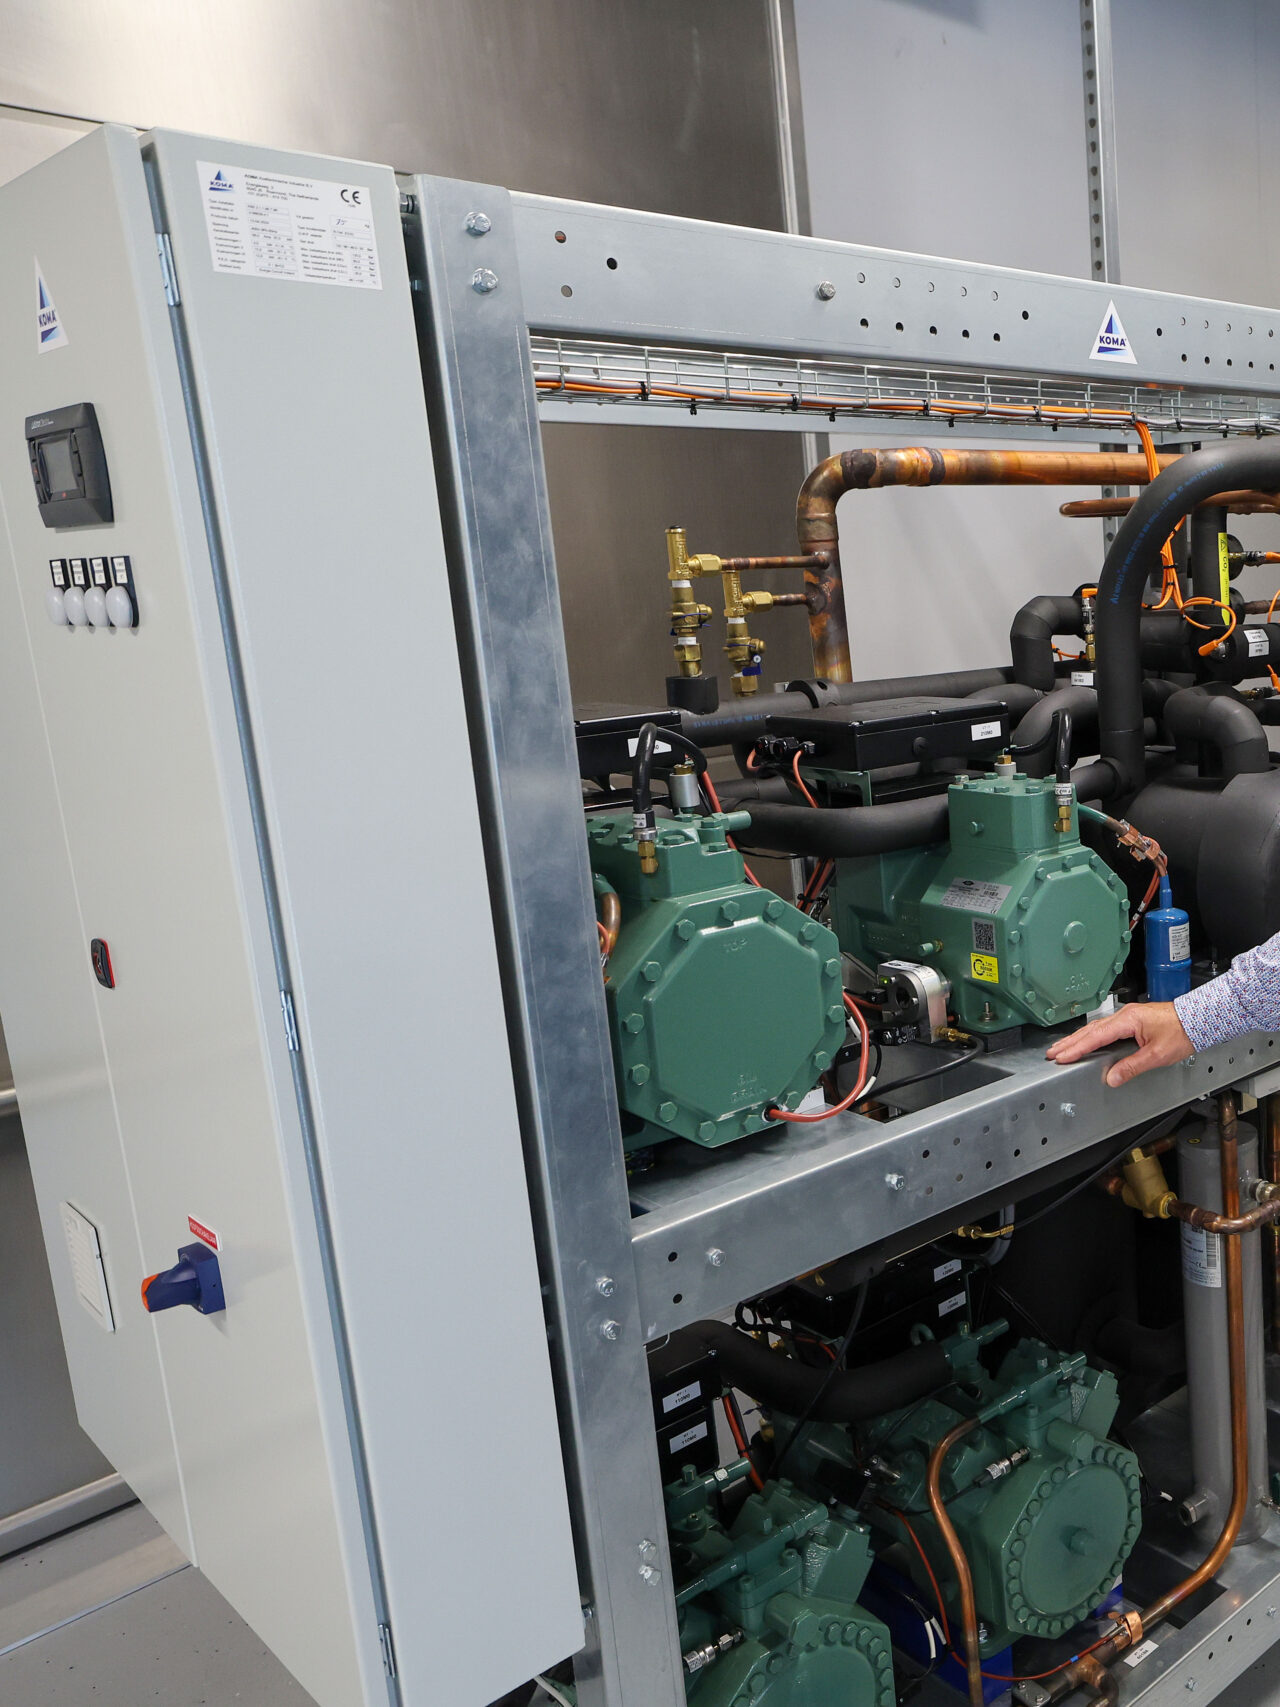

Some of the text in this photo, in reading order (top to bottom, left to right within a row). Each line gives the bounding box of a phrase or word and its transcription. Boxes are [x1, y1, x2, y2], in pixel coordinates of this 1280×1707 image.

[210, 180, 234, 189] KOMA
[38, 310, 57, 328] KOMA
[1099, 335, 1126, 347] KOMA
